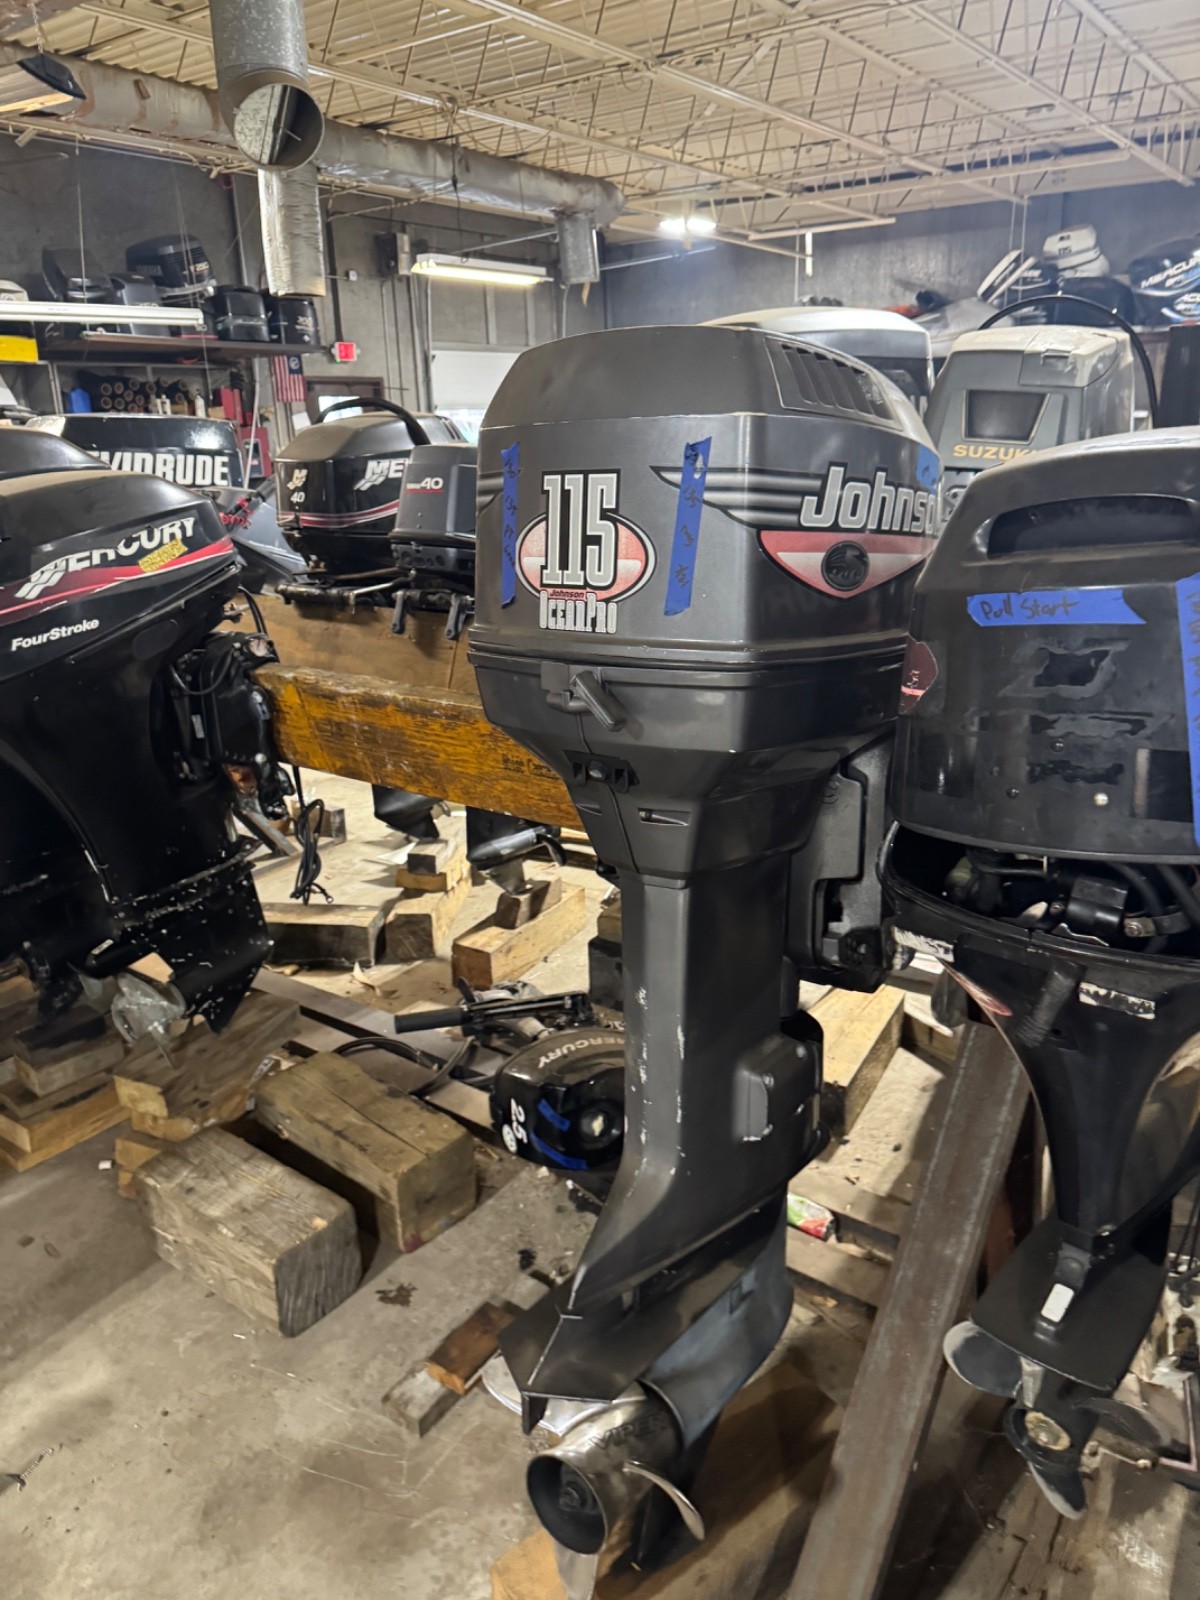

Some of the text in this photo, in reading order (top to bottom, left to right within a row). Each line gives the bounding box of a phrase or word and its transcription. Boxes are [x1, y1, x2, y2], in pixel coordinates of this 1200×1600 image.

[952, 444, 1037, 461] SUZUK
[420, 476, 444, 490] 40
[290, 491, 306, 504] 40
[541, 471, 620, 588] 115
[549, 589, 585, 599] Johnson
[1020, 595, 1080, 620] Start
[10, 617, 100, 652] FourStroke
[510, 1098, 529, 1144] 25
